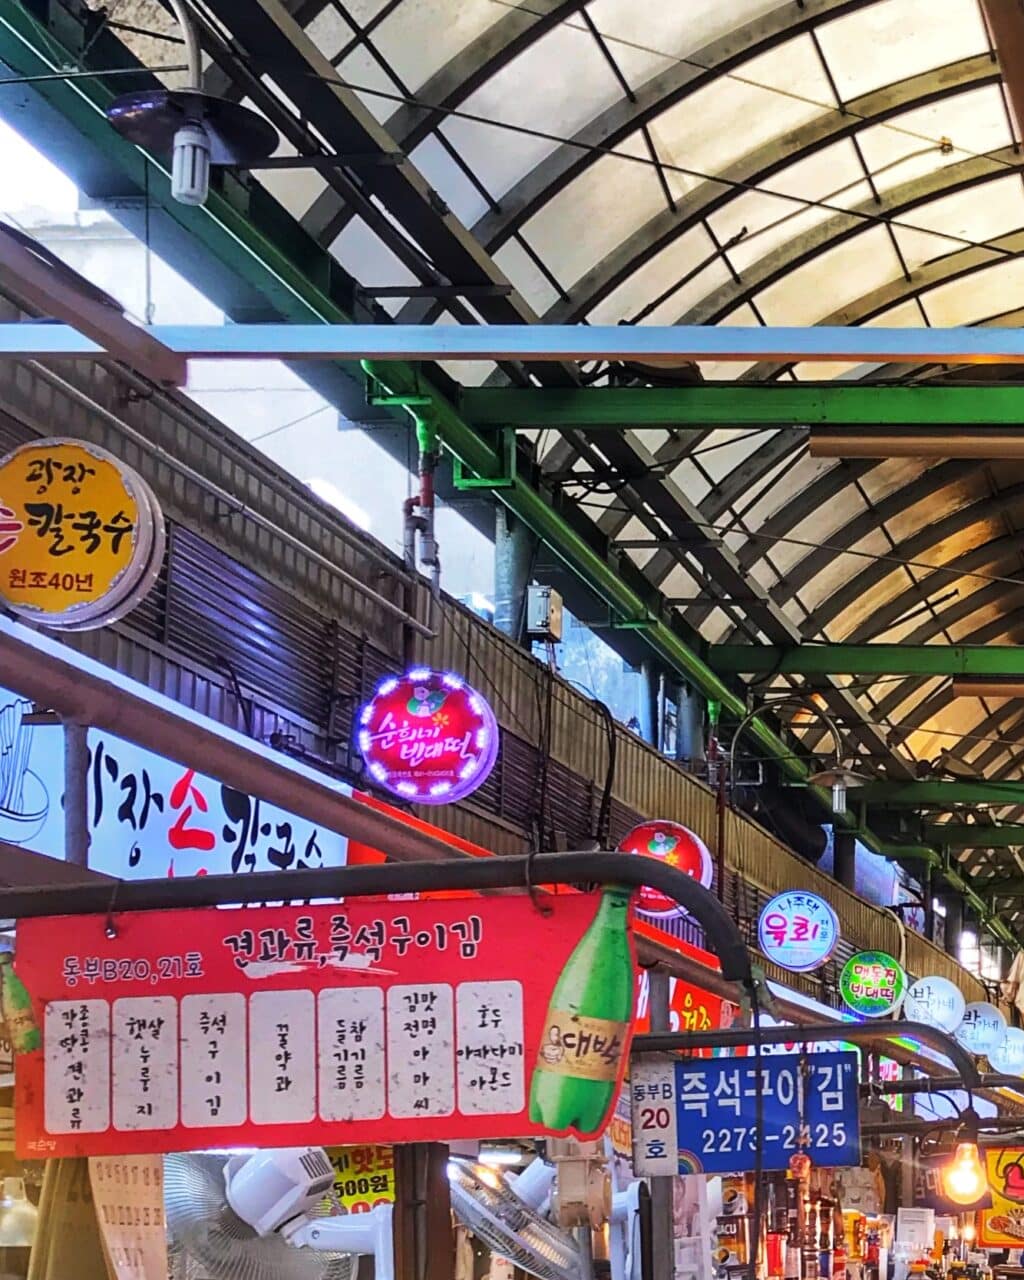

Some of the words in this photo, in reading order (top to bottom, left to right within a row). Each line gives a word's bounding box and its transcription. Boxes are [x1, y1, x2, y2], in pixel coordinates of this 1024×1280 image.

[25, 457, 96, 494] 광장
[23, 502, 134, 557] 칼국수
[8, 568, 94, 592] 원조40년
[401, 731, 475, 768] 빈대떡
[765, 914, 819, 947] 육회
[561, 1026, 621, 1066] 대박
[632, 1083, 673, 1103] 동부B
[640, 1107, 670, 1130] 20
[644, 1139, 668, 1160] 호
